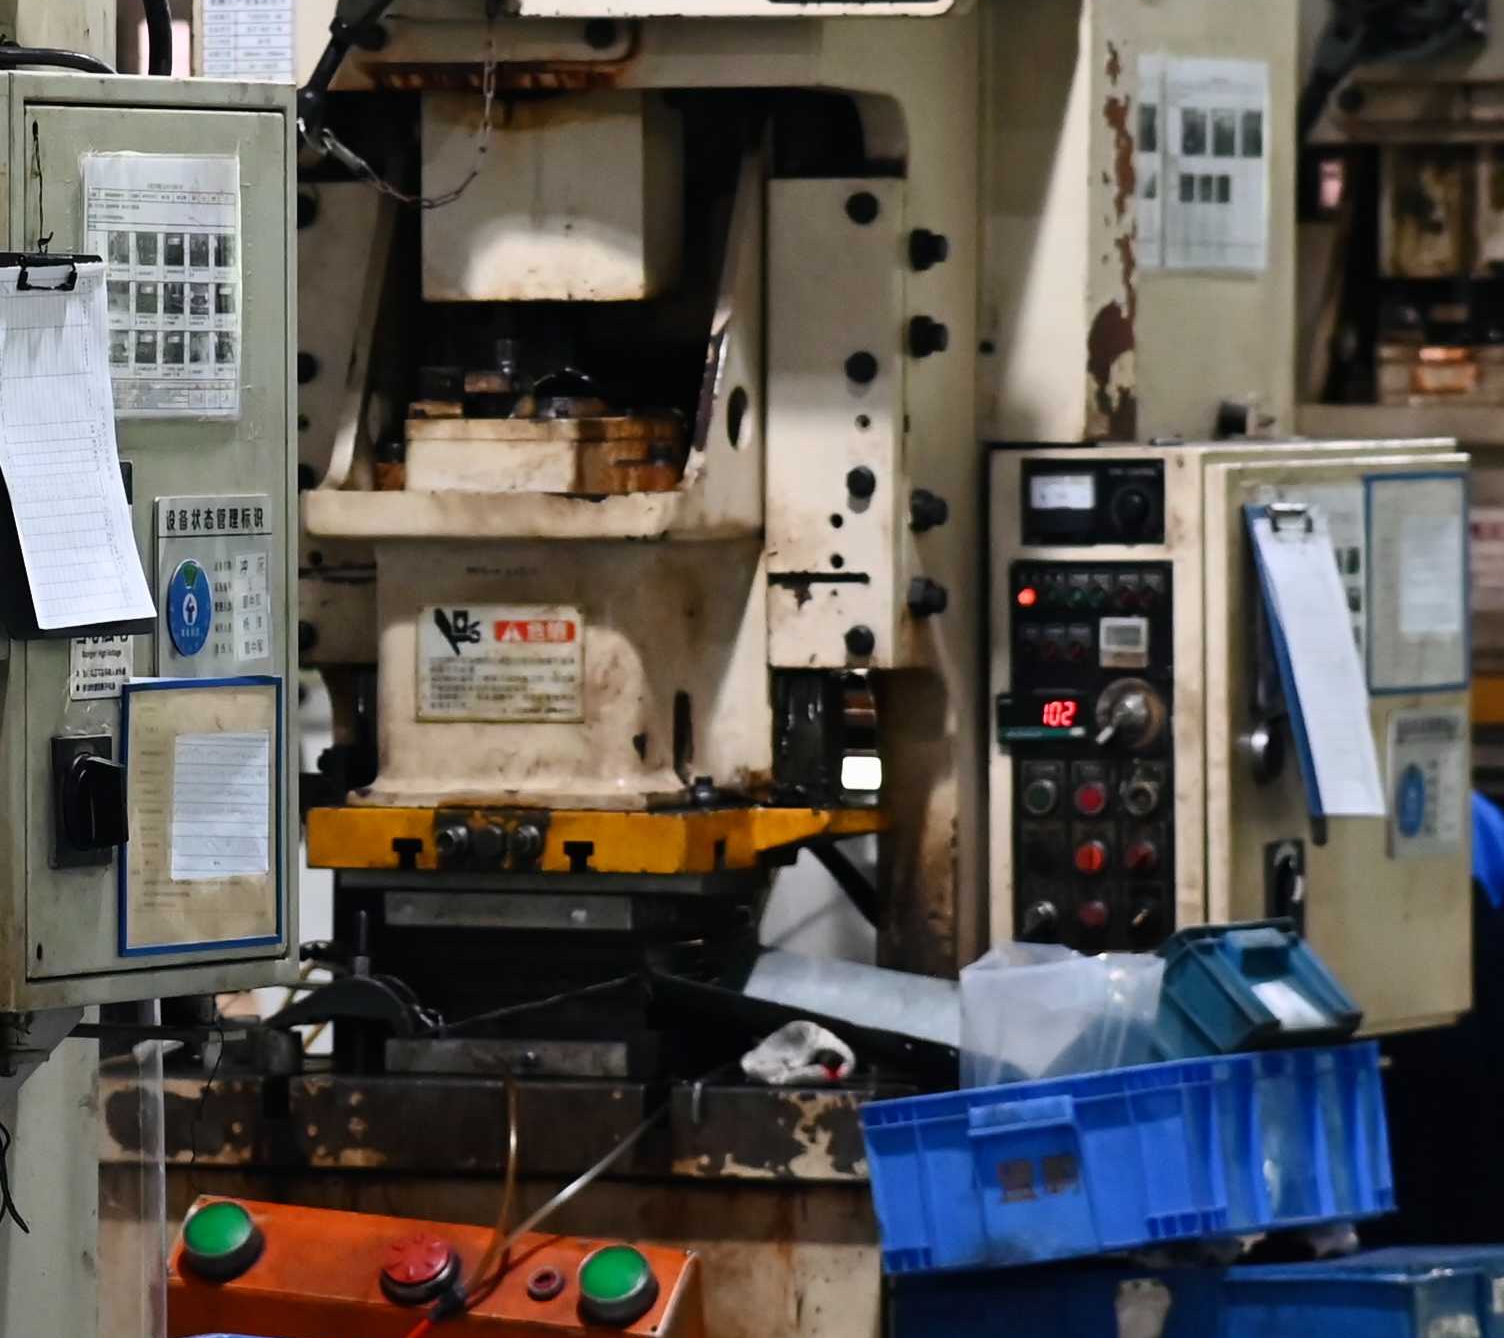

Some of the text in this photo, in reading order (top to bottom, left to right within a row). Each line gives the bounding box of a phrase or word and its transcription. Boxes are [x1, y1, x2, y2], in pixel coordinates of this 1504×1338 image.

[166, 507, 265, 531] 设备状态管理标识
[1041, 699, 1078, 728] 102
